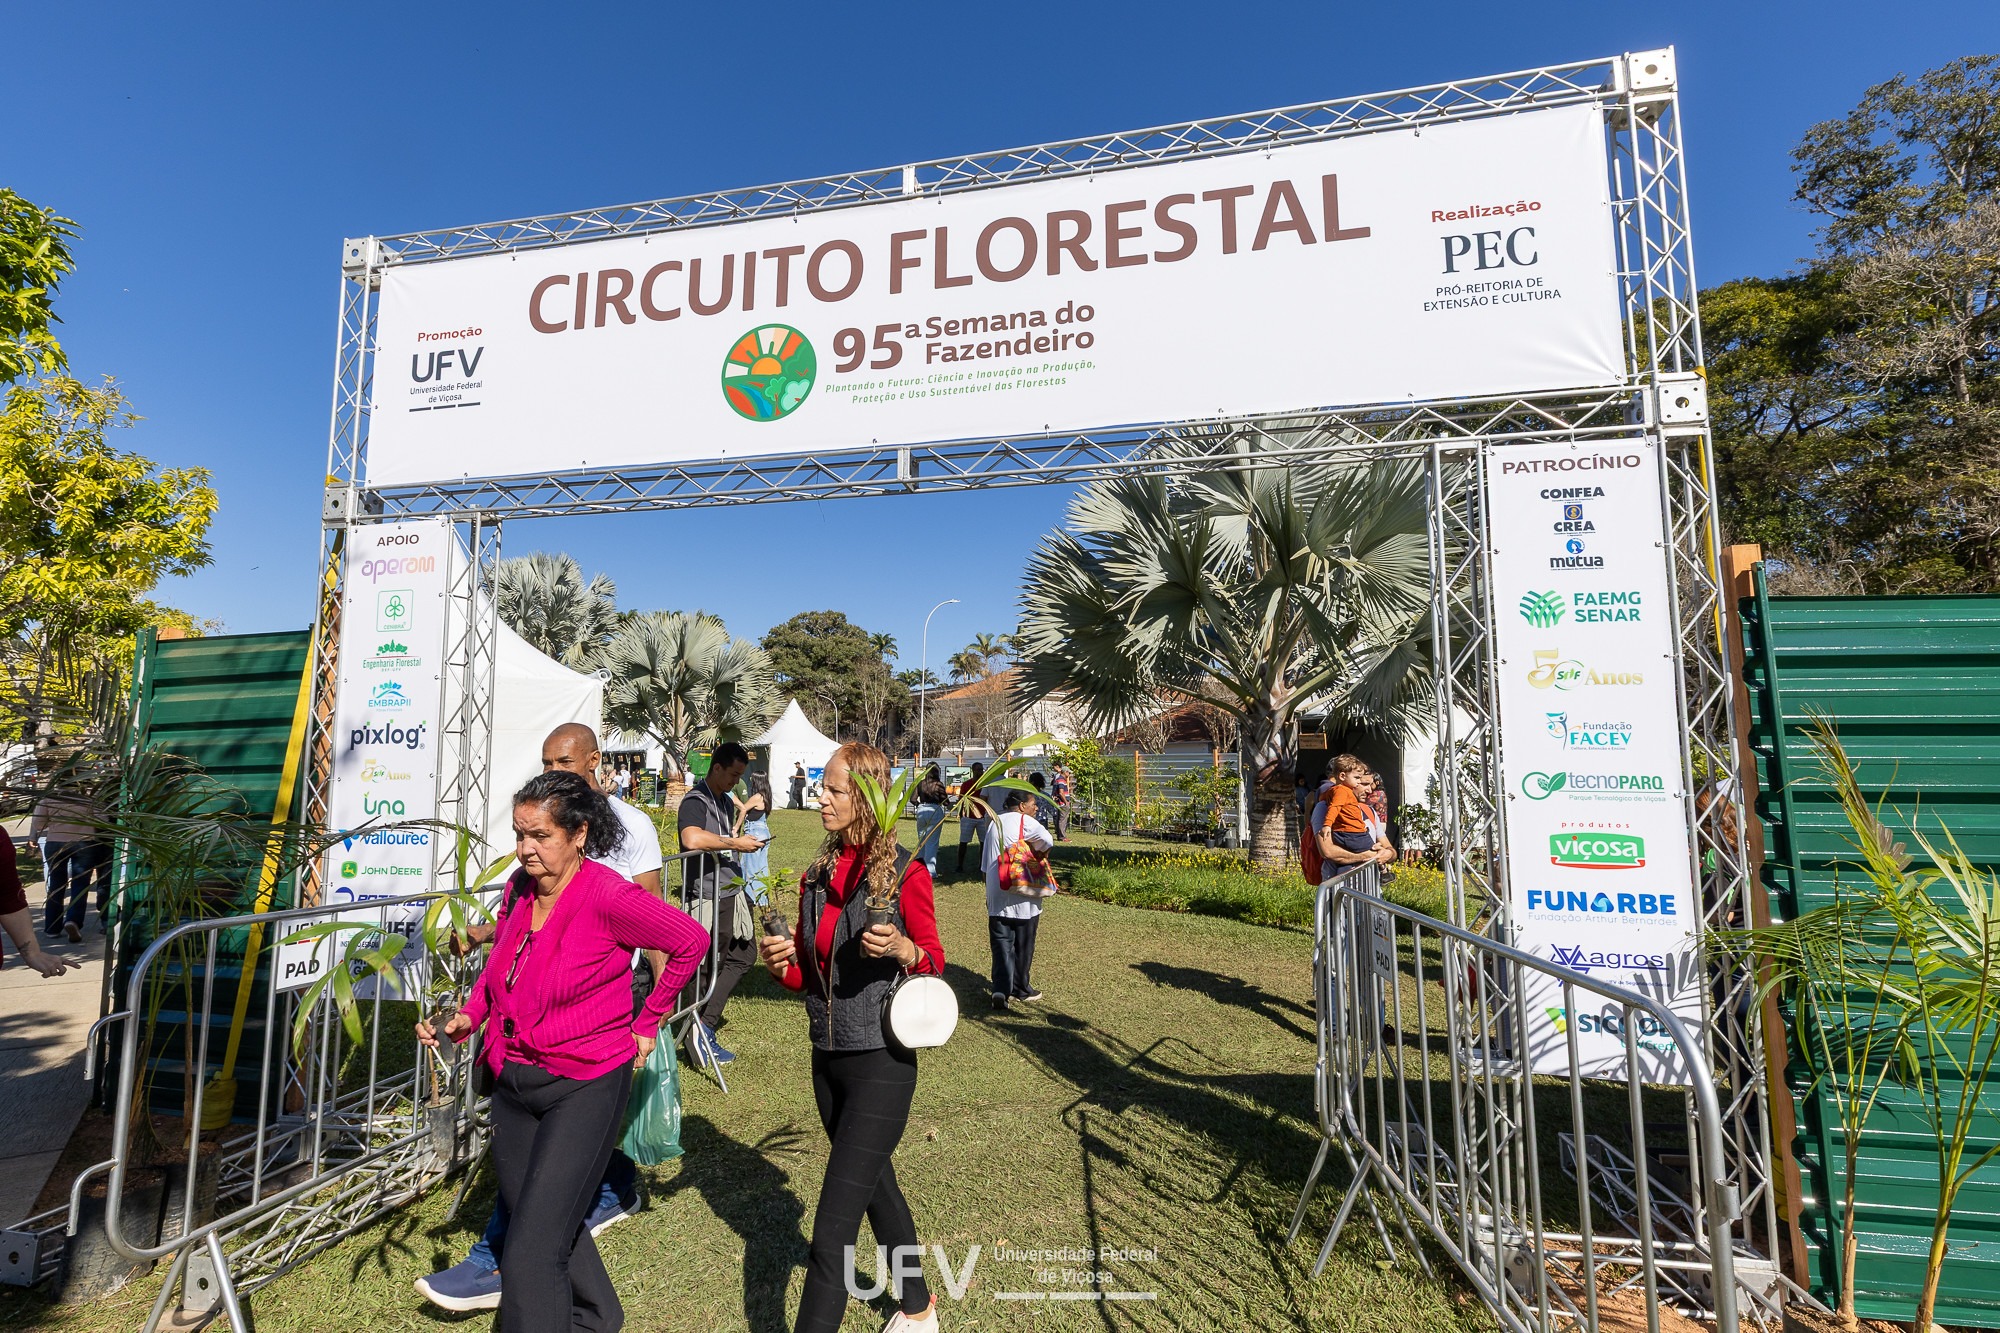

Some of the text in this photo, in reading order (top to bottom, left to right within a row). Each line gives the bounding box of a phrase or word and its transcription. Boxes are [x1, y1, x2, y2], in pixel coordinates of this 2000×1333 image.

[1431, 200, 1542, 223] Realização
[528, 174, 1371, 334] CIRCUITO FLORESTAL
[1440, 226, 1538, 274] PEC
[1436, 277, 1544, 297] PRÓ-REITORIA DE
[1424, 289, 1562, 312] EXTENSÃO E CULTURA
[925, 309, 1048, 339] Semana
[1055, 300, 1095, 326] do
[417, 327, 483, 343] Promoção
[926, 328, 1095, 365] Fazendeiro
[411, 346, 485, 383] UFV
[825, 380, 876, 393] Plantando
[887, 377, 925, 388] Futuro:
[927, 371, 964, 384] Ciência
[976, 366, 1023, 379] Inovação
[1026, 365, 1039, 374] na
[1042, 359, 1096, 373] Produção,
[409, 380, 483, 395] Universidade Federal
[852, 376, 1067, 404] Proteção e Uso Sustentável das Florestas
[428, 394, 463, 404] de Viçosa
[1502, 453, 1641, 475] PATROCÍNIO
[1540, 486, 1606, 500] CONFEA
[1553, 520, 1596, 533] CREA
[376, 534, 420, 547] APOIO
[361, 555, 435, 585] aperam
[1574, 591, 1642, 606] FAEMG
[1574, 608, 1642, 623] SENAR
[362, 657, 422, 670] Engenharia Florestal
[1584, 667, 1644, 686] Anos
[368, 698, 412, 708] EMBRAPII
[1583, 721, 1633, 732] Fundação
[1570, 731, 1632, 746] FACEV
[385, 769, 412, 781] Anos
[1568, 771, 1665, 790] tecnoPARQ
[364, 797, 405, 816] una
[1568, 794, 1592, 802] Parque
[1594, 795, 1633, 803] Tecnológico
[1643, 795, 1667, 803] Viçosa
[1561, 820, 1630, 830] produtos
[364, 830, 429, 846] vallourec
[1555, 835, 1639, 861] viçosa
[361, 865, 423, 876] JOHN DEERE
[1528, 912, 1678, 927] Fundação Arthur Bernardes
[285, 959, 321, 979] PAD
[1375, 949, 1390, 972] PAD
[1589, 951, 1665, 969] agros
